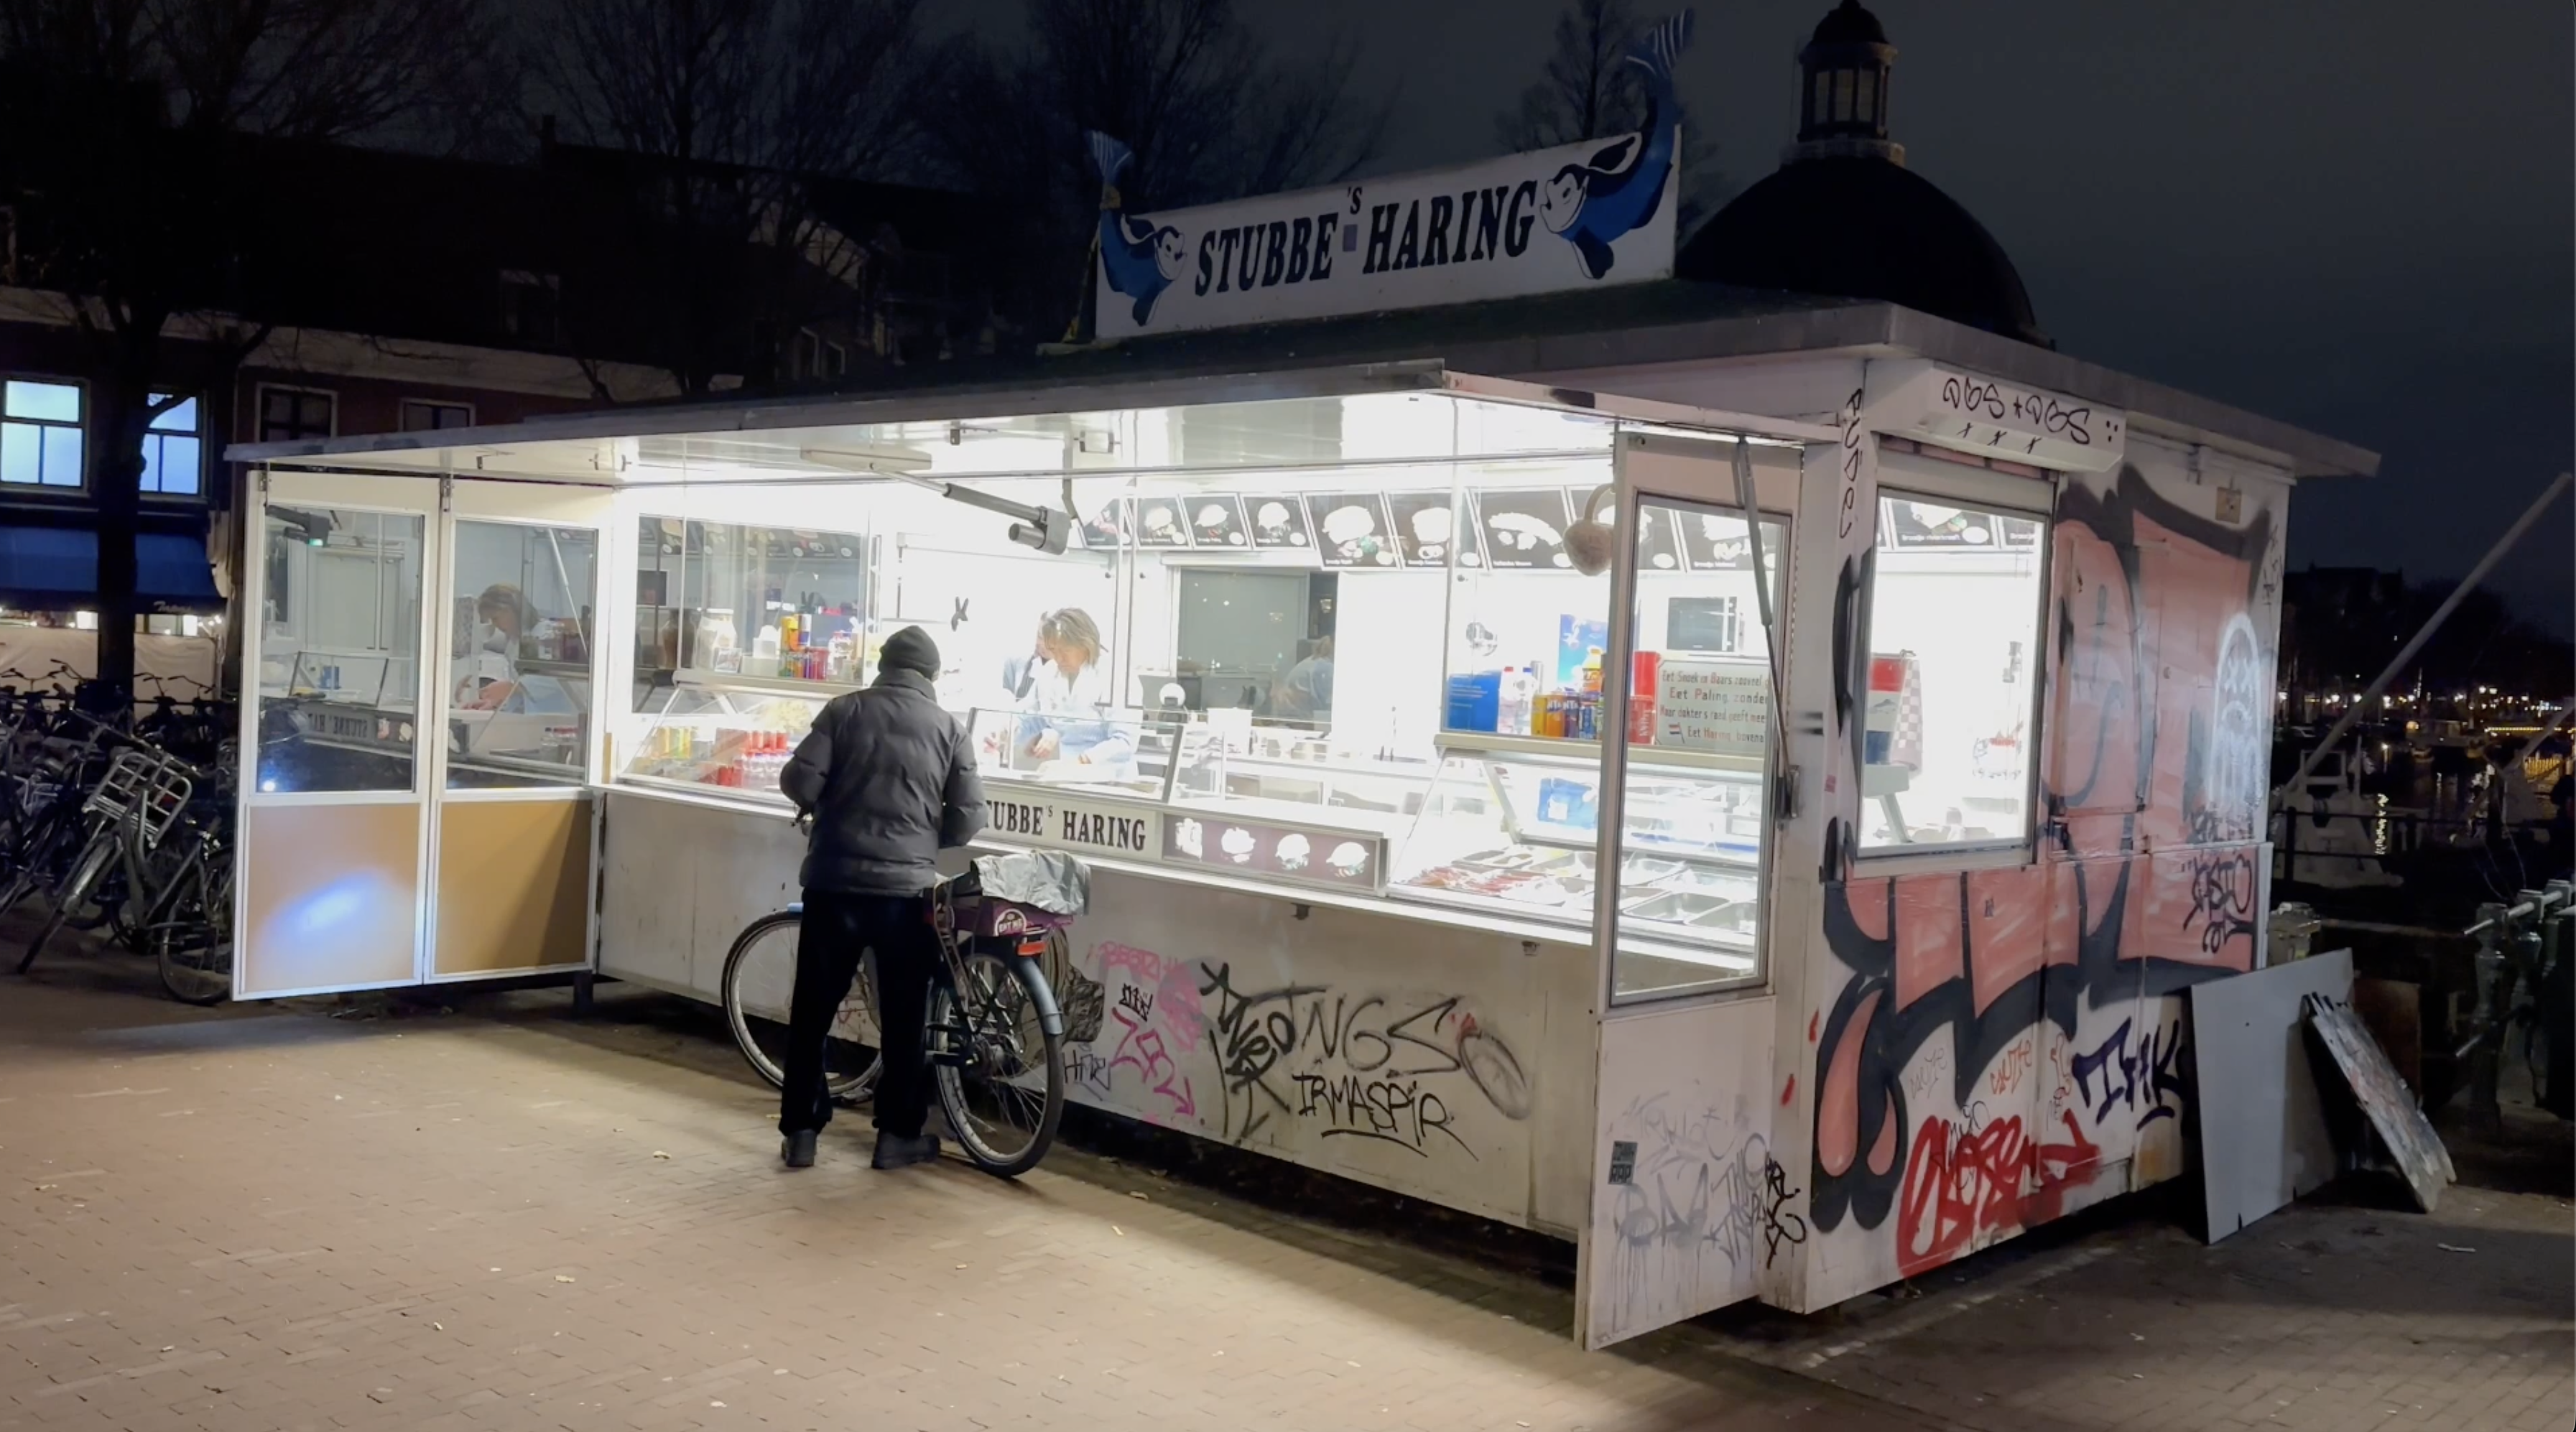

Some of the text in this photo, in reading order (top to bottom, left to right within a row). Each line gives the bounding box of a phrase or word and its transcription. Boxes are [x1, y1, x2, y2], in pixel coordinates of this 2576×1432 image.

[1363, 180, 1538, 274] HARING
[1662, 670, 1675, 682] Eet
[1669, 687, 1688, 699] Eet
[1695, 688, 1729, 705] Paling
[1687, 725, 1702, 738] Eet
[1062, 811, 1146, 851] HARING
